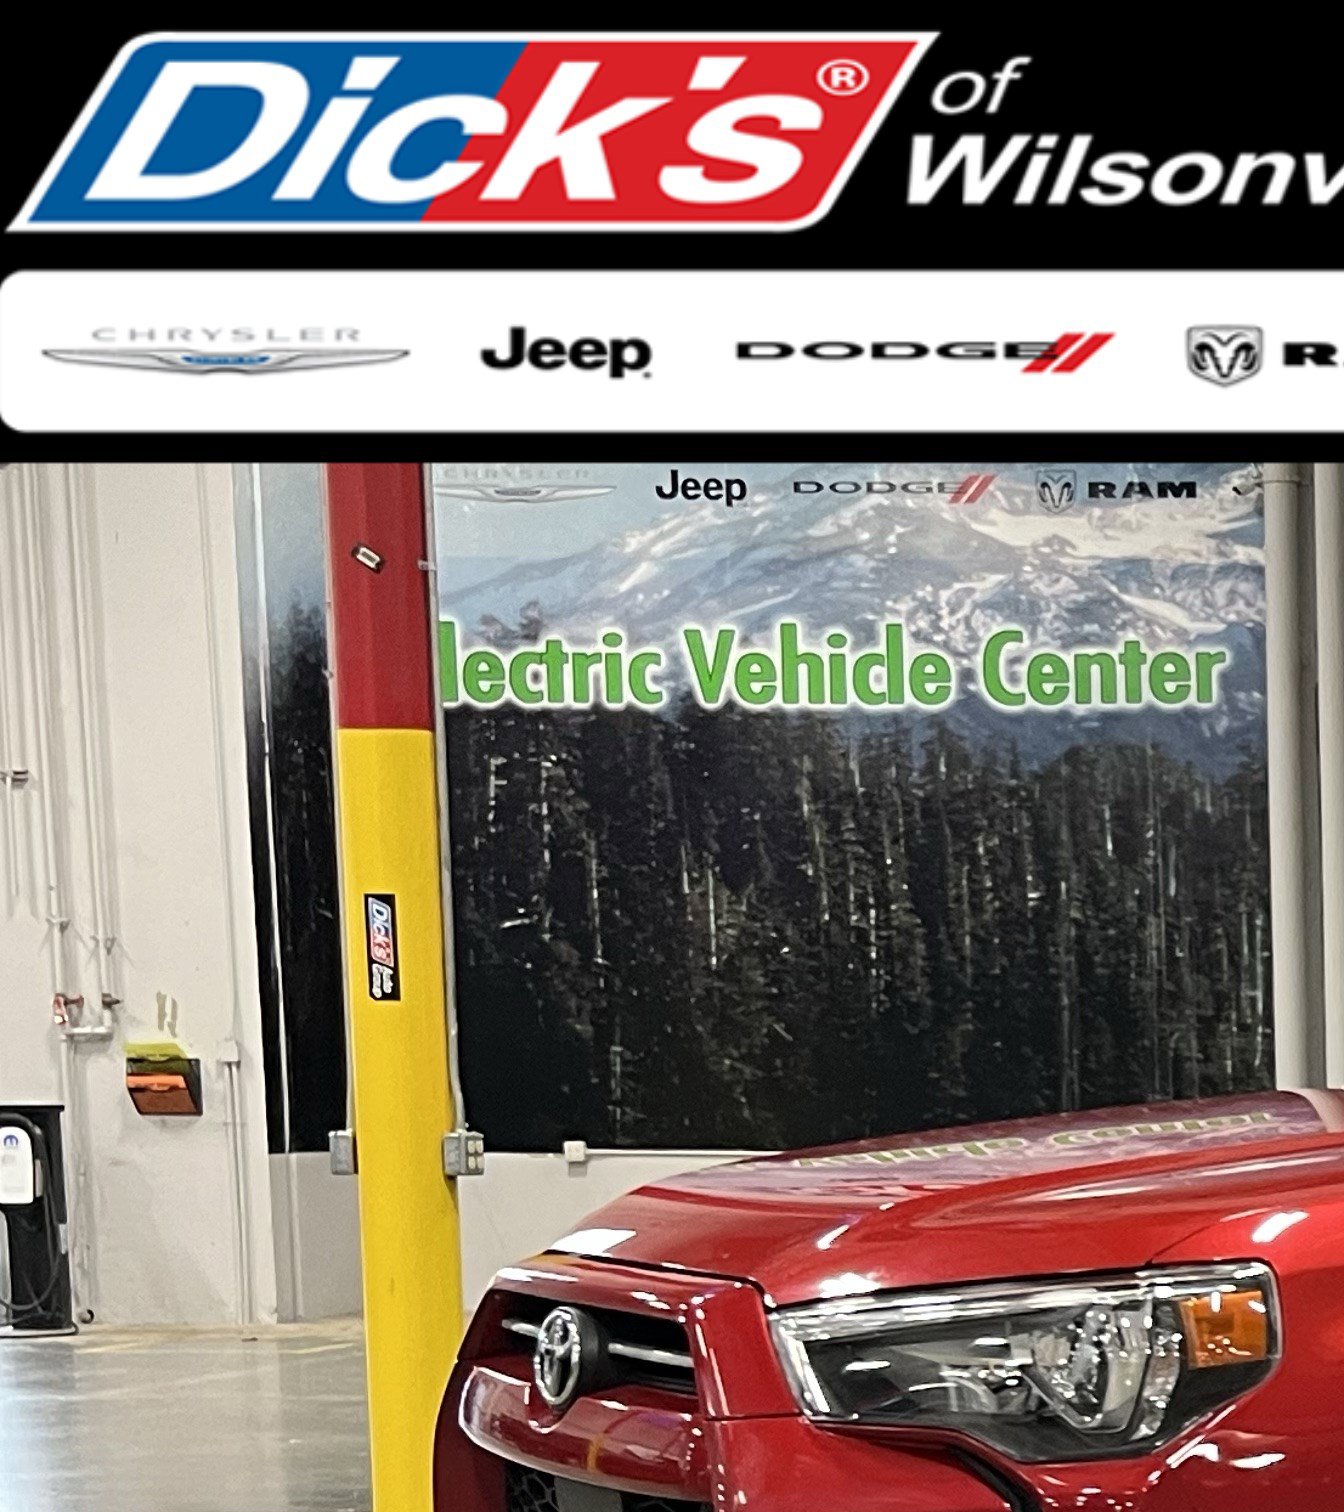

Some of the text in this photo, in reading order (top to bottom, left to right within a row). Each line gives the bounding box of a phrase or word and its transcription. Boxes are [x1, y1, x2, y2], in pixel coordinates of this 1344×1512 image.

[655, 469, 748, 508] Jeep
[793, 481, 957, 495] DODGE
[1088, 481, 1198, 499] RAM
[684, 622, 952, 704] Vehicle
[982, 630, 1226, 704] Center
